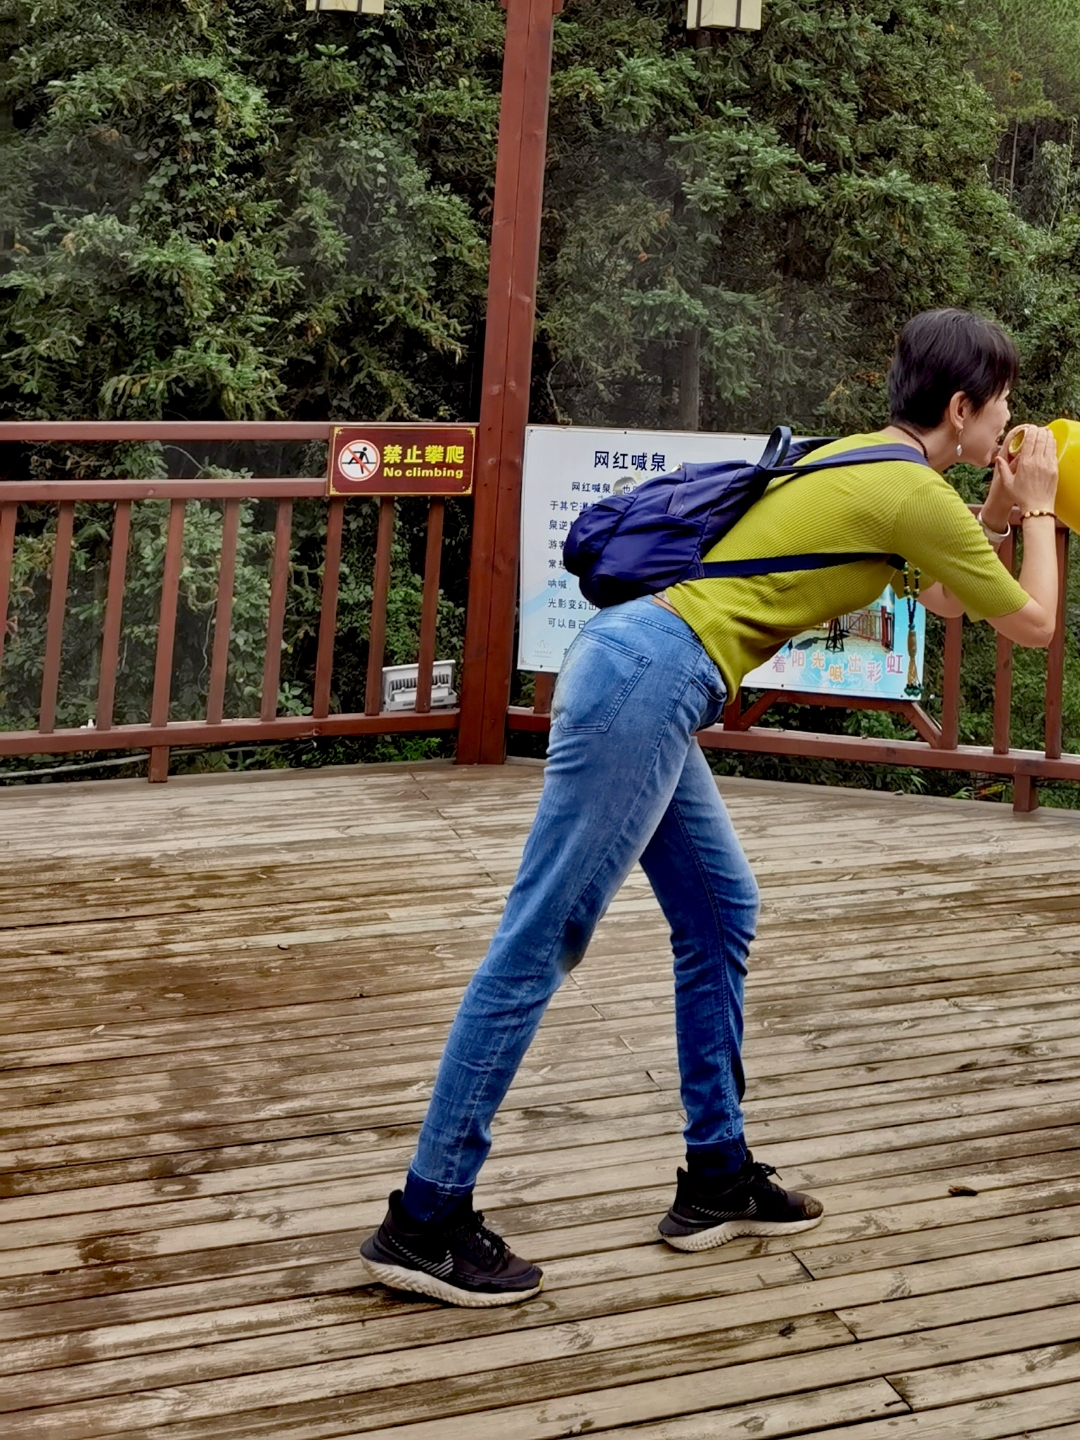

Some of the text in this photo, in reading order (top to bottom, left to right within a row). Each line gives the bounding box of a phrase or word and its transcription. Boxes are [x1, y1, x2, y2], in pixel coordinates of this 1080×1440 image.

[383, 444, 465, 465] 禁止攀爬
[594, 450, 666, 472] 网红喊泉
[383, 467, 463, 479] No climbing
[773, 650, 903, 682] 着阳光喊出彩虹
